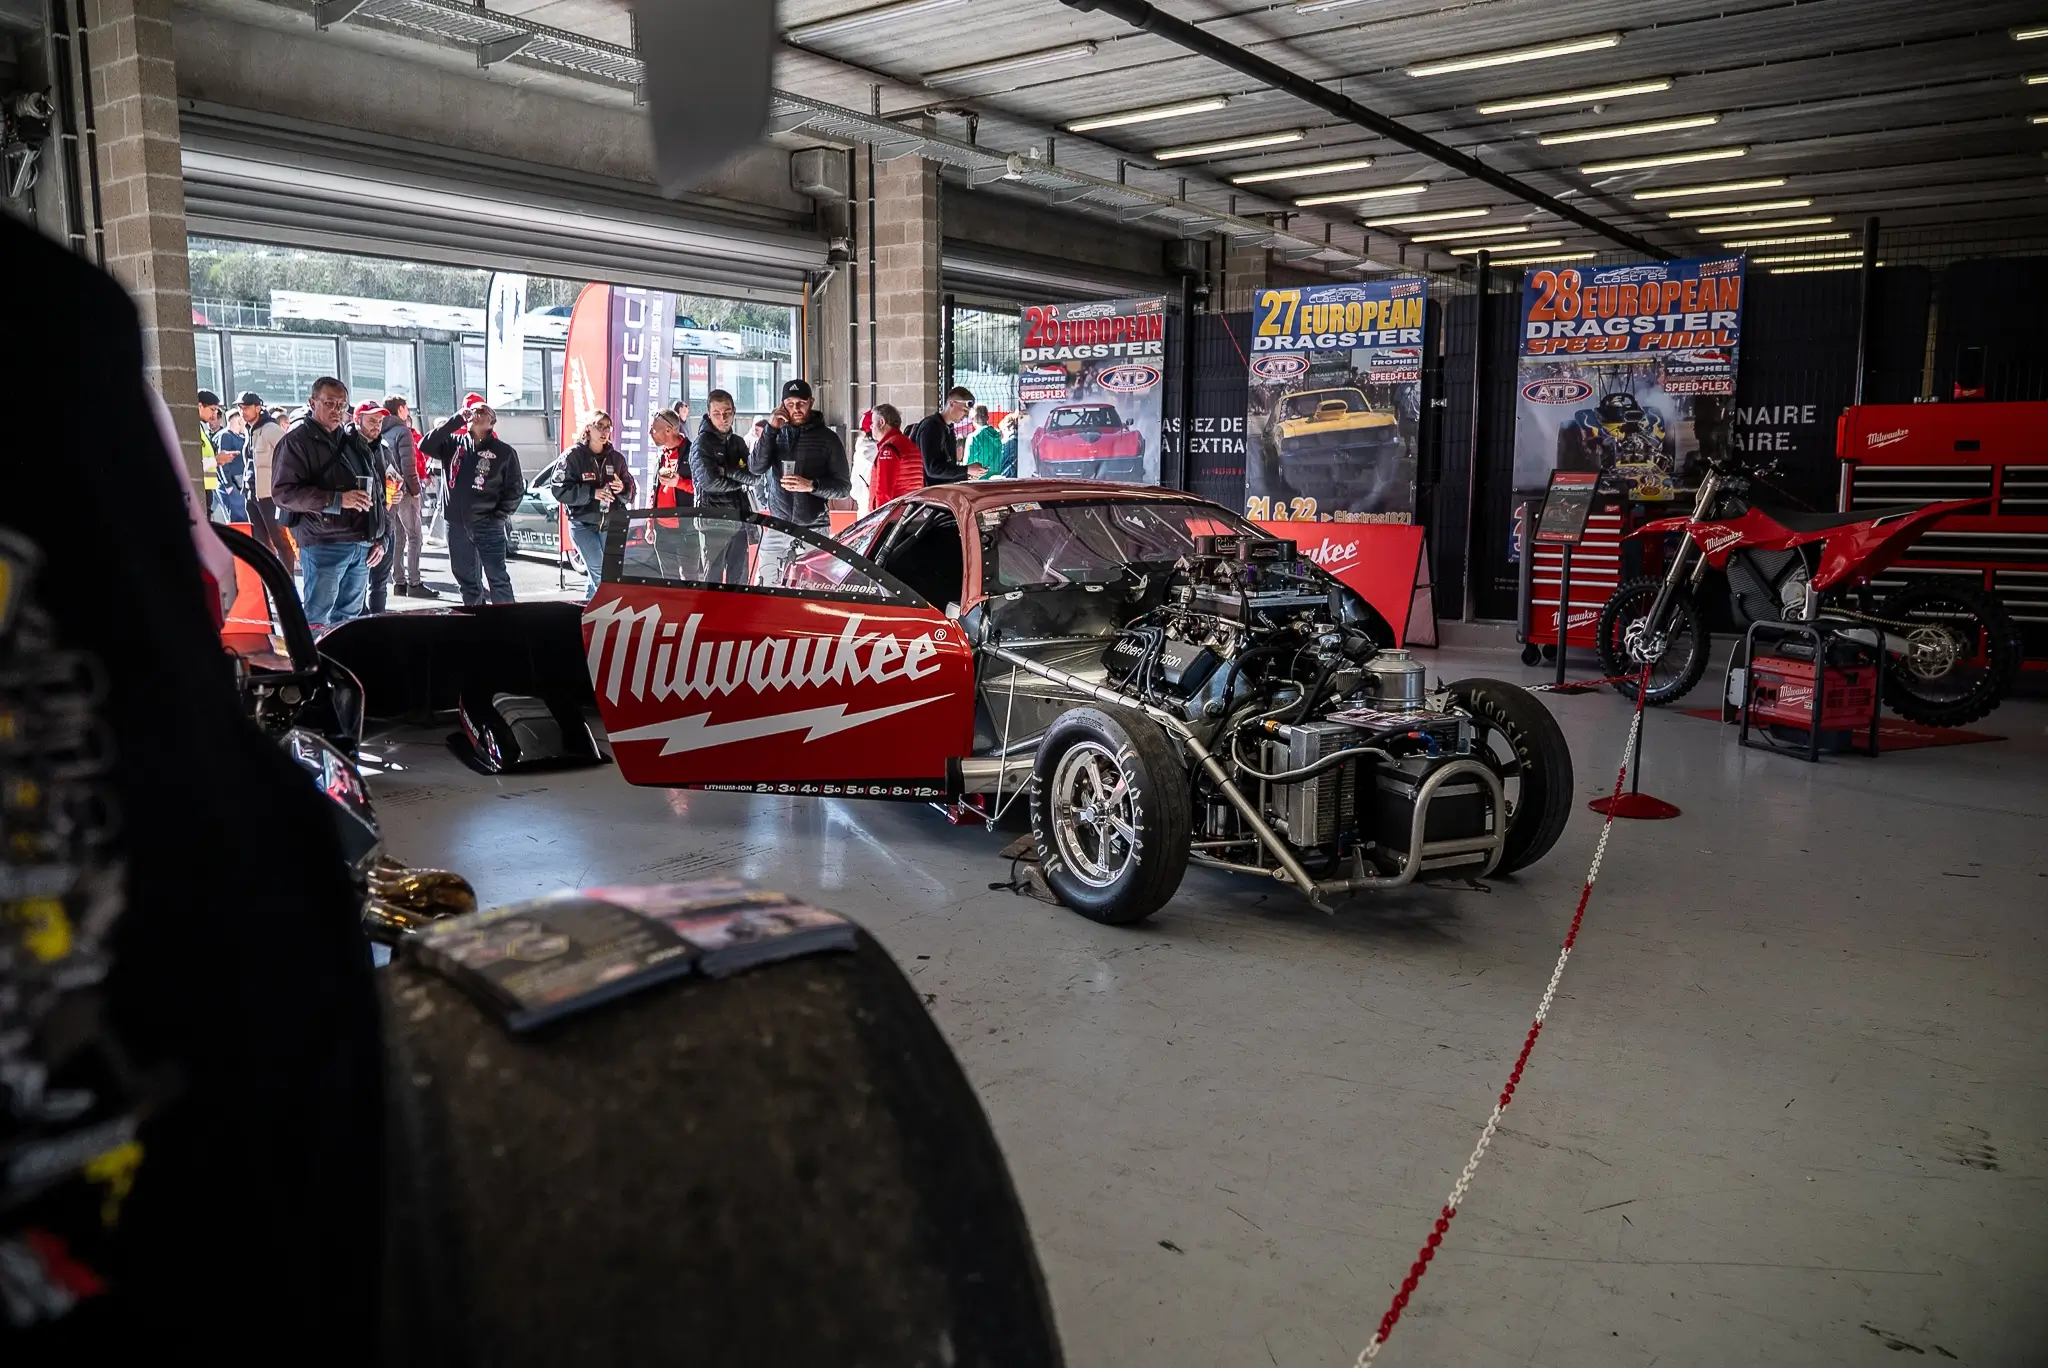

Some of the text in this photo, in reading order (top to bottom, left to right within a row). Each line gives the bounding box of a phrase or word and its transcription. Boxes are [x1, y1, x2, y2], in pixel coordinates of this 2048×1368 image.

[1582, 276, 1740, 319] EUROPEAN
[1300, 297, 1423, 335] EUROPEAN
[1526, 311, 1738, 339] DRAGSTER
[1060, 312, 1164, 347] EUROPEAN
[1253, 329, 1421, 351] DRAGSTER
[1526, 329, 1738, 355] SPEED FINAL
[1021, 341, 1162, 362] DRAGSTER
[1262, 360, 1298, 373] ATD
[1666, 365, 1731, 373] TROPHEE
[1021, 376, 1066, 384] TROPHEE
[1109, 370, 1148, 385] ATD
[1370, 372, 1418, 381] SPEED-FLEX
[1021, 389, 1066, 400] SPEED-FLEX
[1535, 385, 1579, 399] ATD
[1665, 381, 1729, 392] SPEED-FLEX
[620, 288, 646, 511] HIFTEC
[1736, 404, 1817, 426] NAIRE
[1220, 417, 1243, 433] DE
[1866, 428, 1909, 446] Milwaukee
[1246, 496, 1270, 522] 21
[1273, 501, 1289, 522] &
[1290, 497, 1317, 522] 22
[509, 530, 560, 546] SHIFTEC
[1703, 531, 1744, 551] Milwaukee
[800, 580, 879, 595] Patrick DUBOIS
[1551, 609, 1598, 627] Mwaukee
